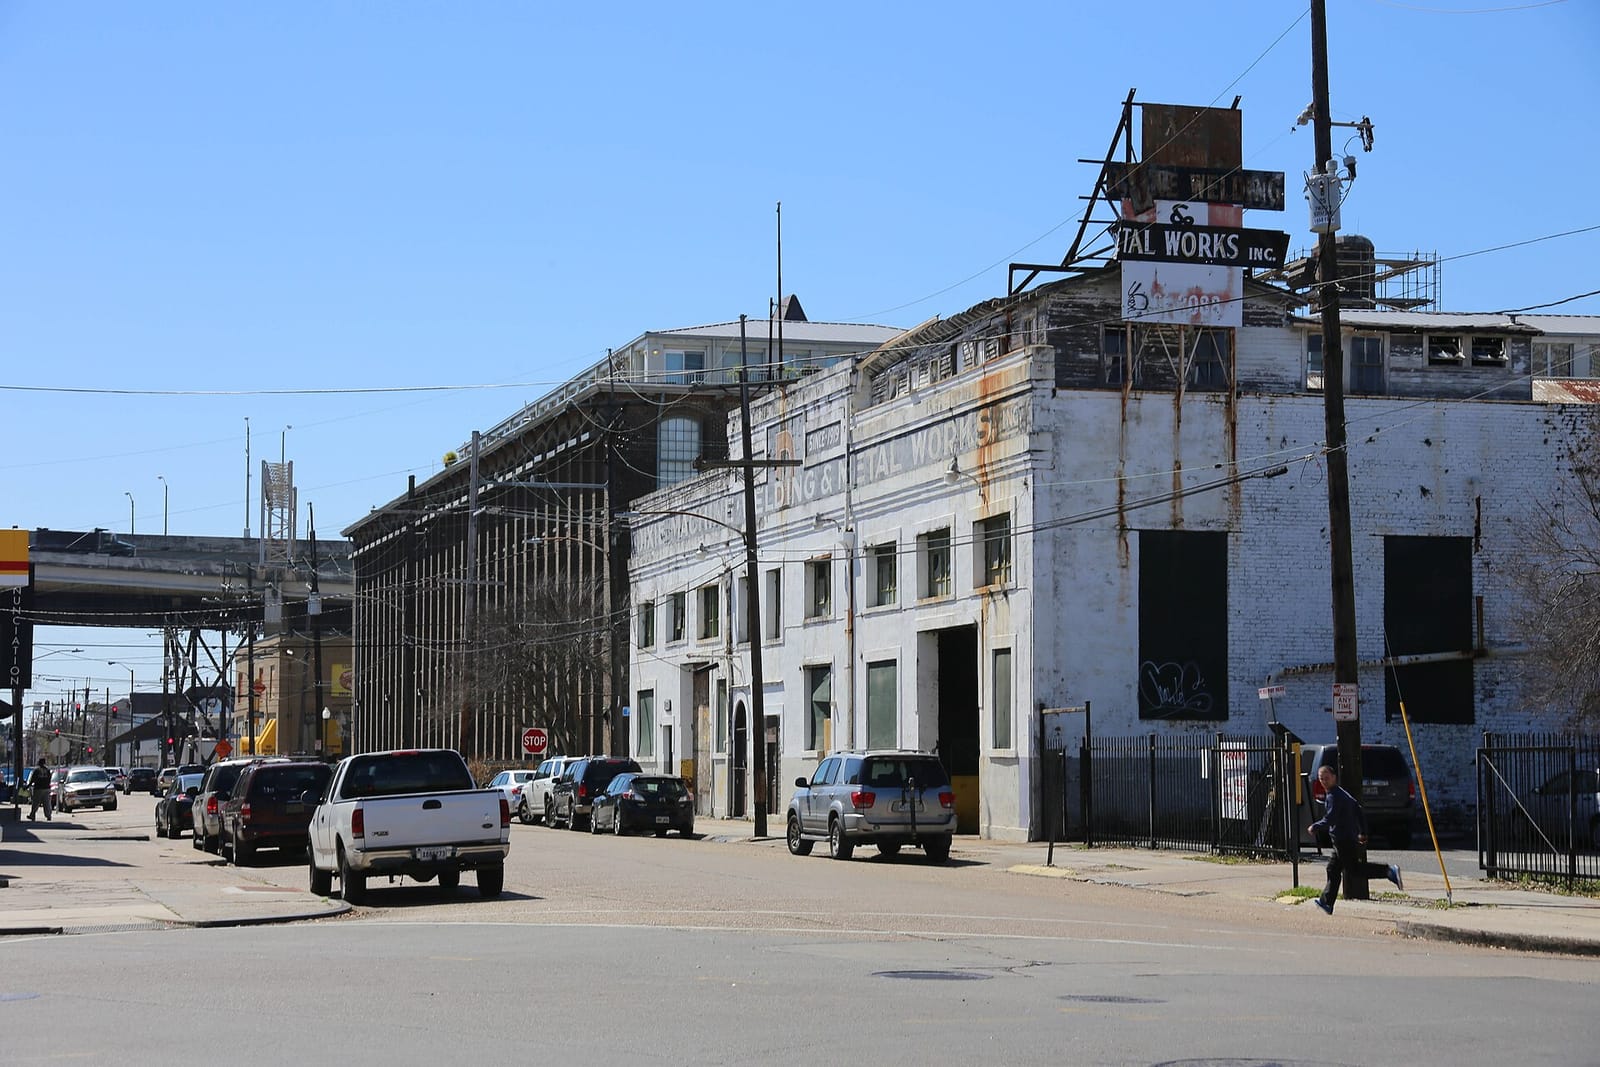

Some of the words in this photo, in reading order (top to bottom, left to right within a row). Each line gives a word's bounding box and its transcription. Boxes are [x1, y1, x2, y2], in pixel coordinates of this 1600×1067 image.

[1170, 203, 1194, 225] &
[1164, 230, 1239, 260] WORKS
[1249, 247, 1277, 262] INC.
[735, 469, 816, 514] ELDING
[821, 464, 833, 495] &
[911, 408, 992, 465] WORKS
[524, 735, 546, 747] STOP
